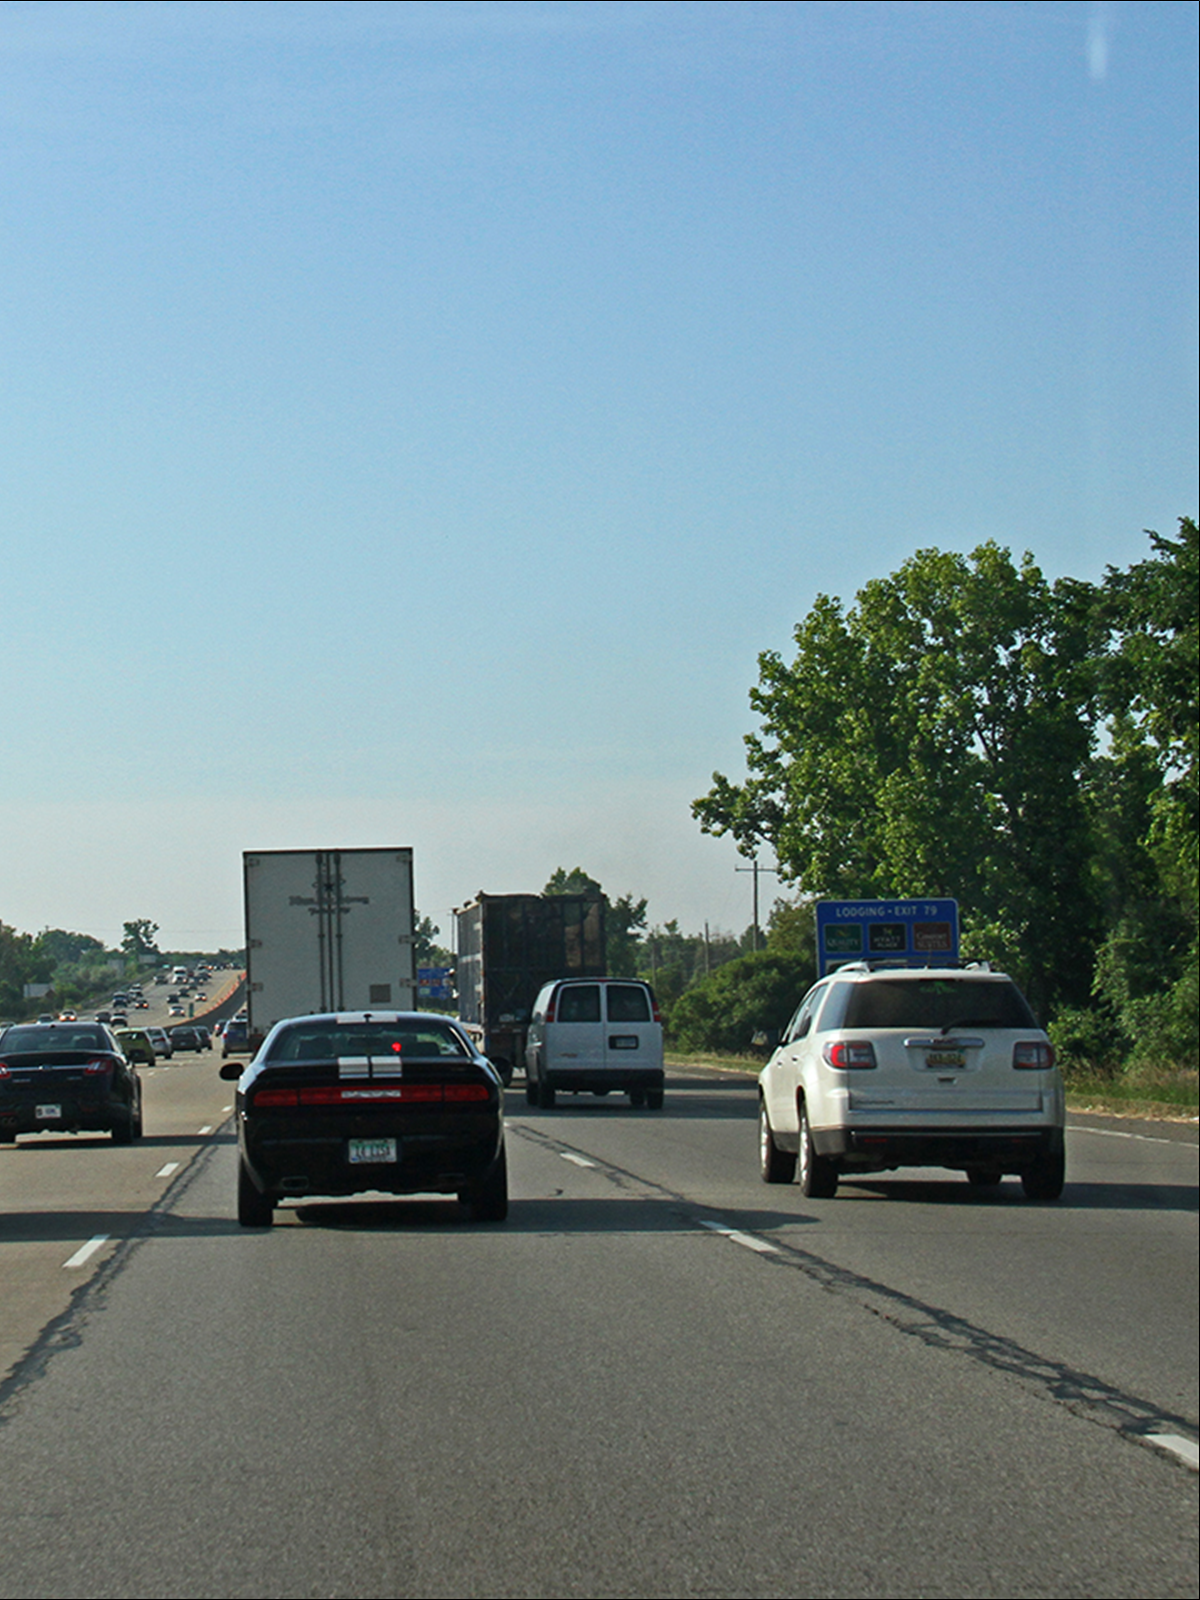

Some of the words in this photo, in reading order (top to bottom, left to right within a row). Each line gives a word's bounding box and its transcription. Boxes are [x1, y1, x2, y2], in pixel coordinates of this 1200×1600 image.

[836, 906, 885, 917] LODGING
[894, 906, 917, 916] EXIT
[924, 905, 937, 915] 79
